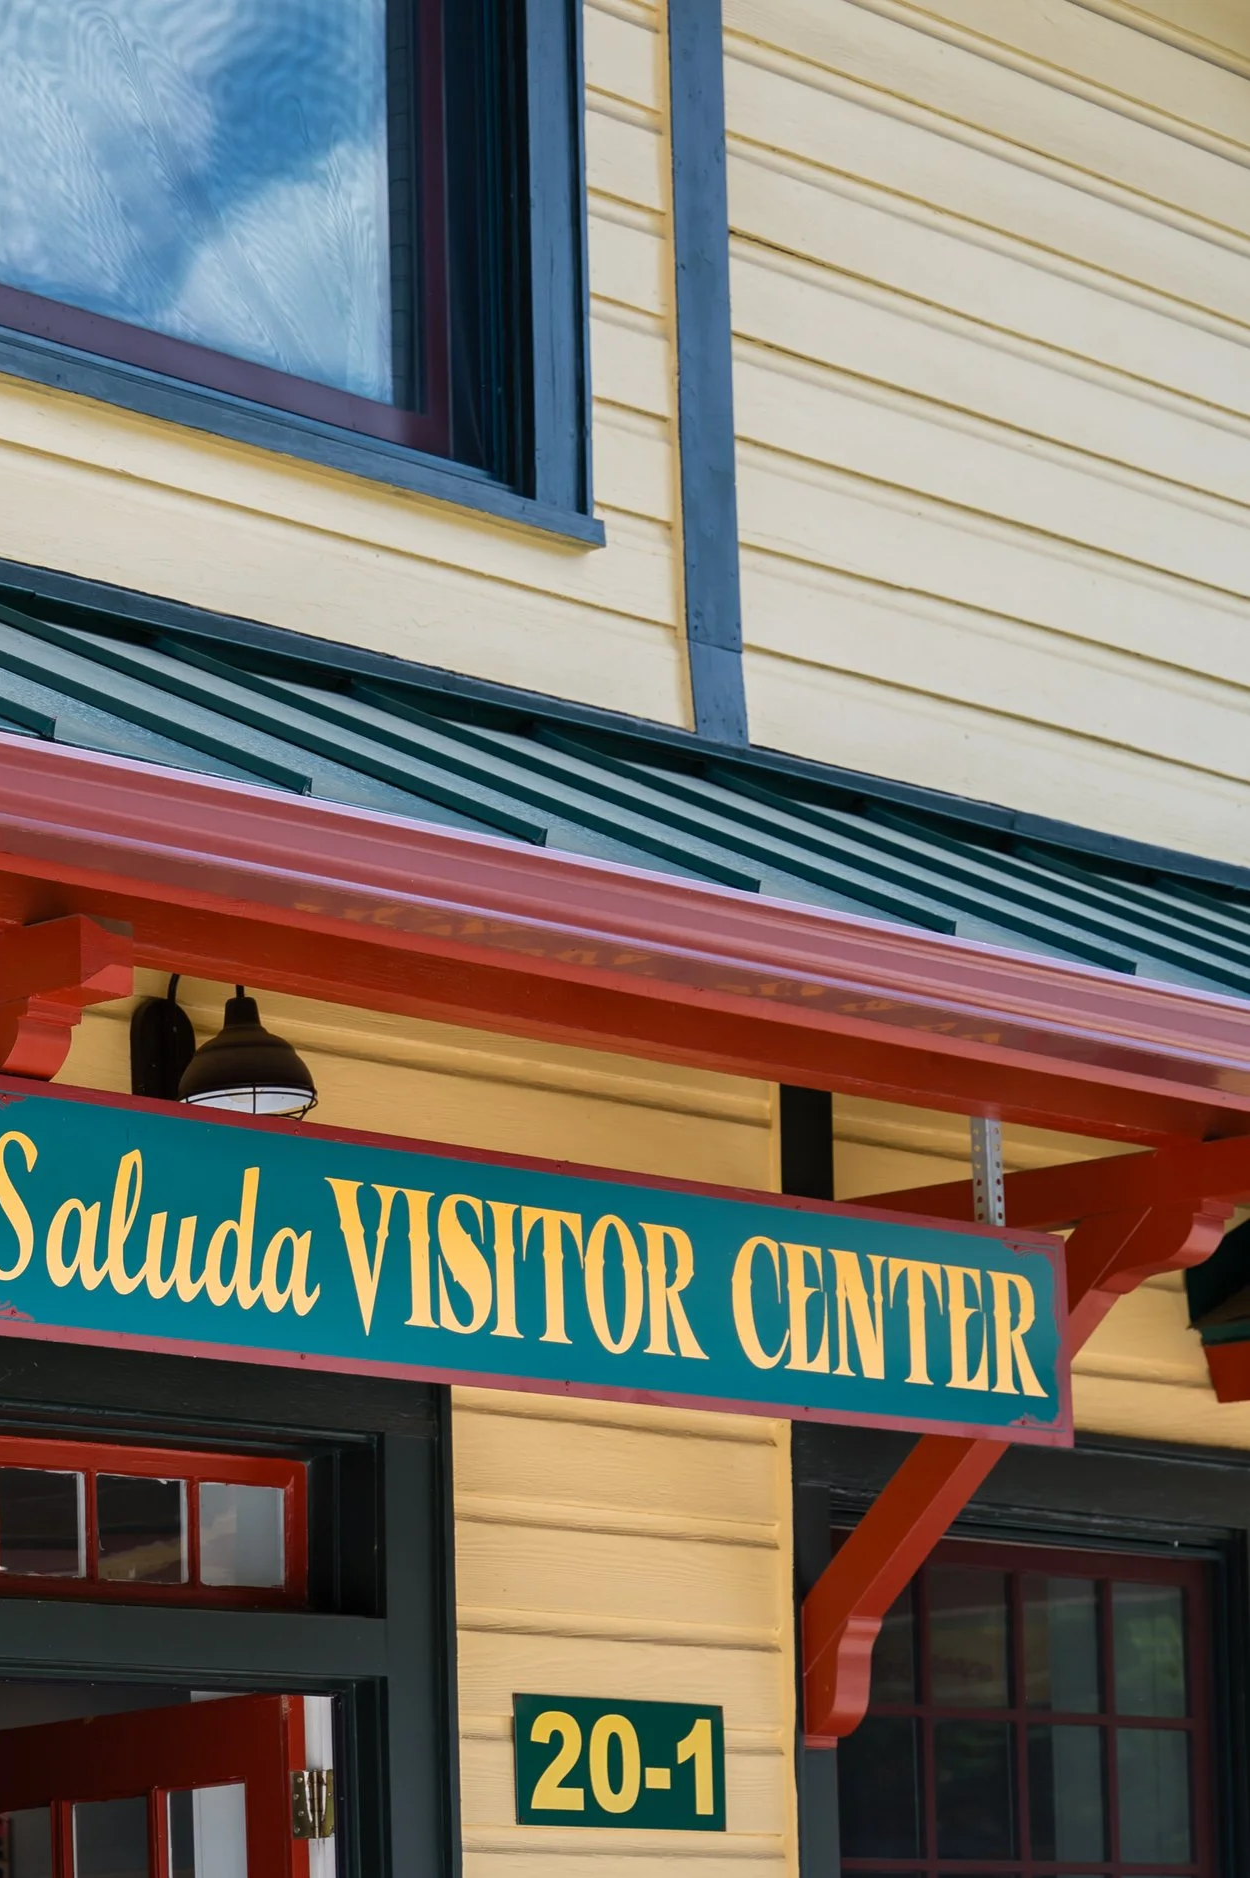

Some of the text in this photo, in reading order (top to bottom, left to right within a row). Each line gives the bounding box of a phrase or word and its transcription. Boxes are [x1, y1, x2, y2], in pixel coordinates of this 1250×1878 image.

[323, 1176, 710, 1360] VISITOR
[731, 1235, 1049, 1399] CENTER
[529, 1710, 716, 1816] 20-1
